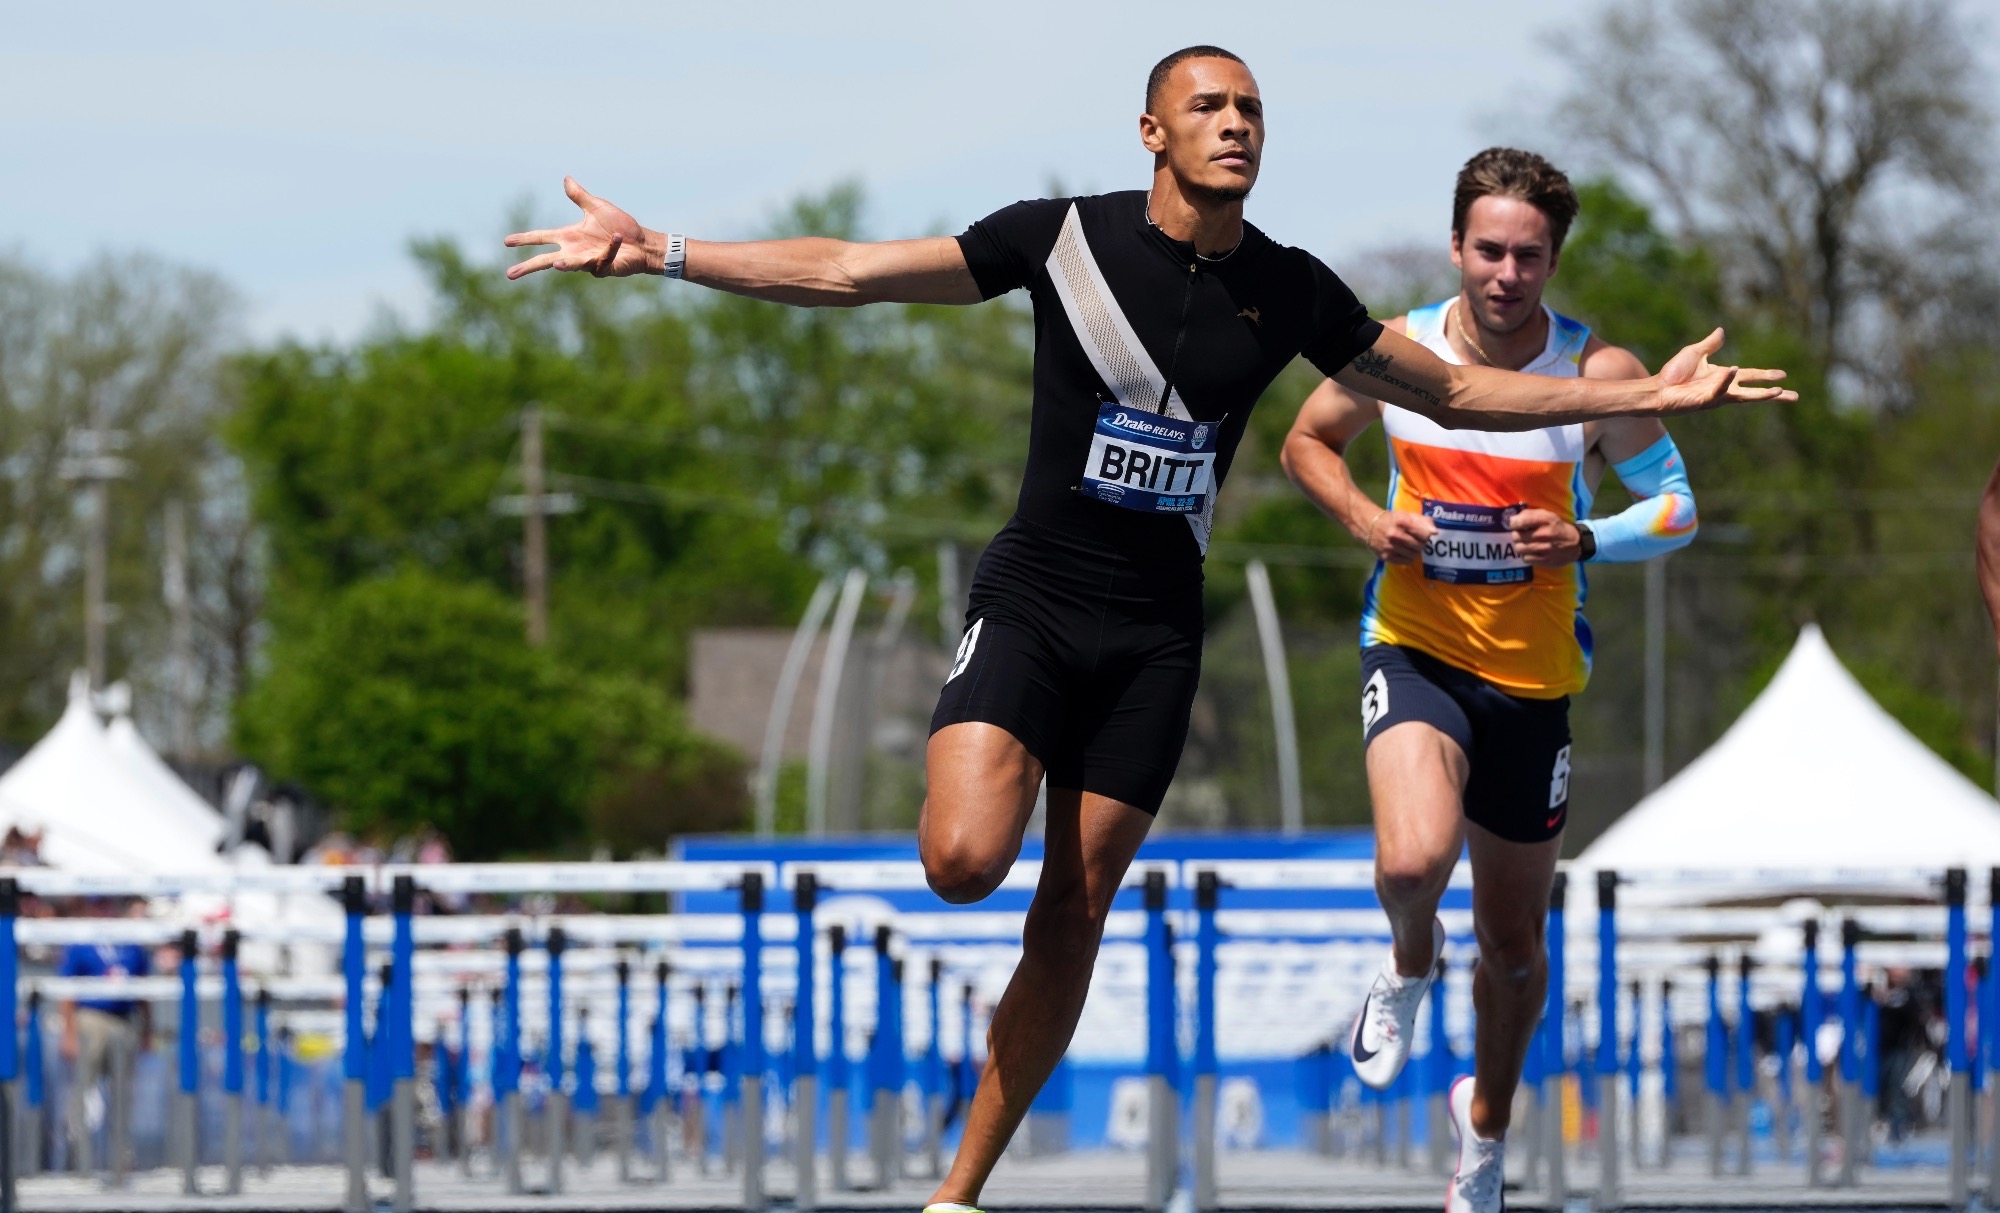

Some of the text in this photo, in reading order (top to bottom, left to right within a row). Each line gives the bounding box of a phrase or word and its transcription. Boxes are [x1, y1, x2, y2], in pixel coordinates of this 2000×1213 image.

[1112, 412, 1186, 440] Drake RELAYS
[1099, 444, 1205, 492] BRITT
[1432, 505, 1494, 523] Drake RELAYS
[1424, 539, 1521, 561] SCHULMA
[1363, 683, 1379, 728] 3
